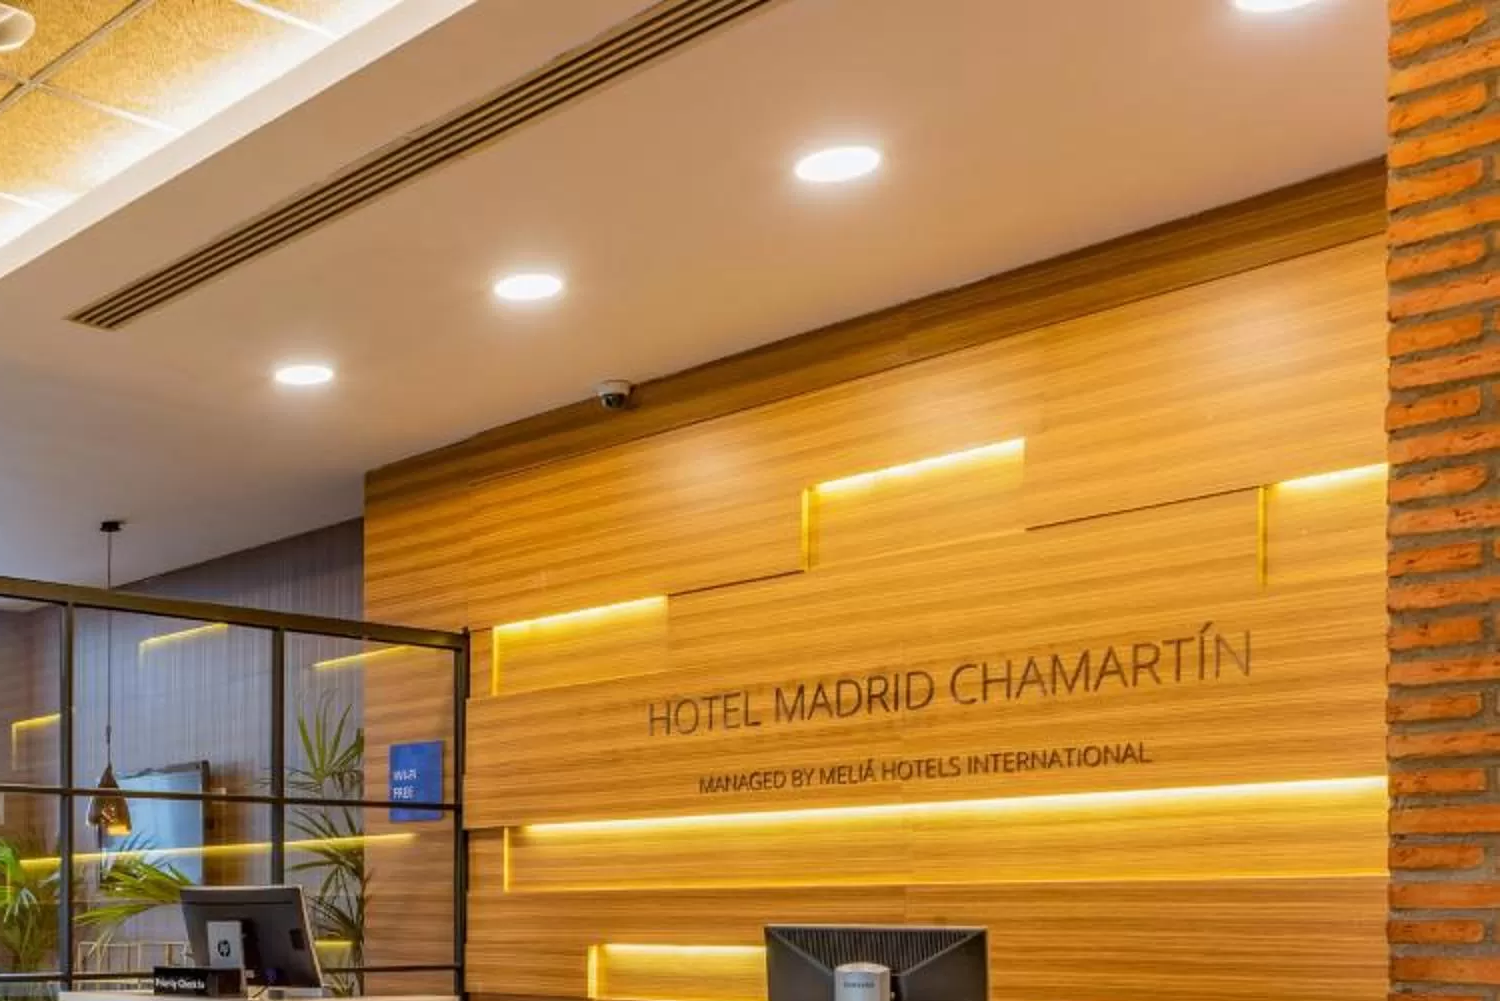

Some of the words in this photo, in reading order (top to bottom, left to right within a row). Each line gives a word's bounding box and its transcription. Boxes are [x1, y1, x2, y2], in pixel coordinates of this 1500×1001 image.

[649, 690, 762, 737] HOTEL
[774, 670, 935, 723] MADRID
[949, 620, 1251, 705] CHAMARTÍN
[699, 769, 787, 794] MANAGED
[791, 767, 816, 788] BY
[819, 758, 877, 786] MELIÁ
[882, 755, 961, 781] HOTELS
[967, 741, 1153, 775] INTERNATIONAL
